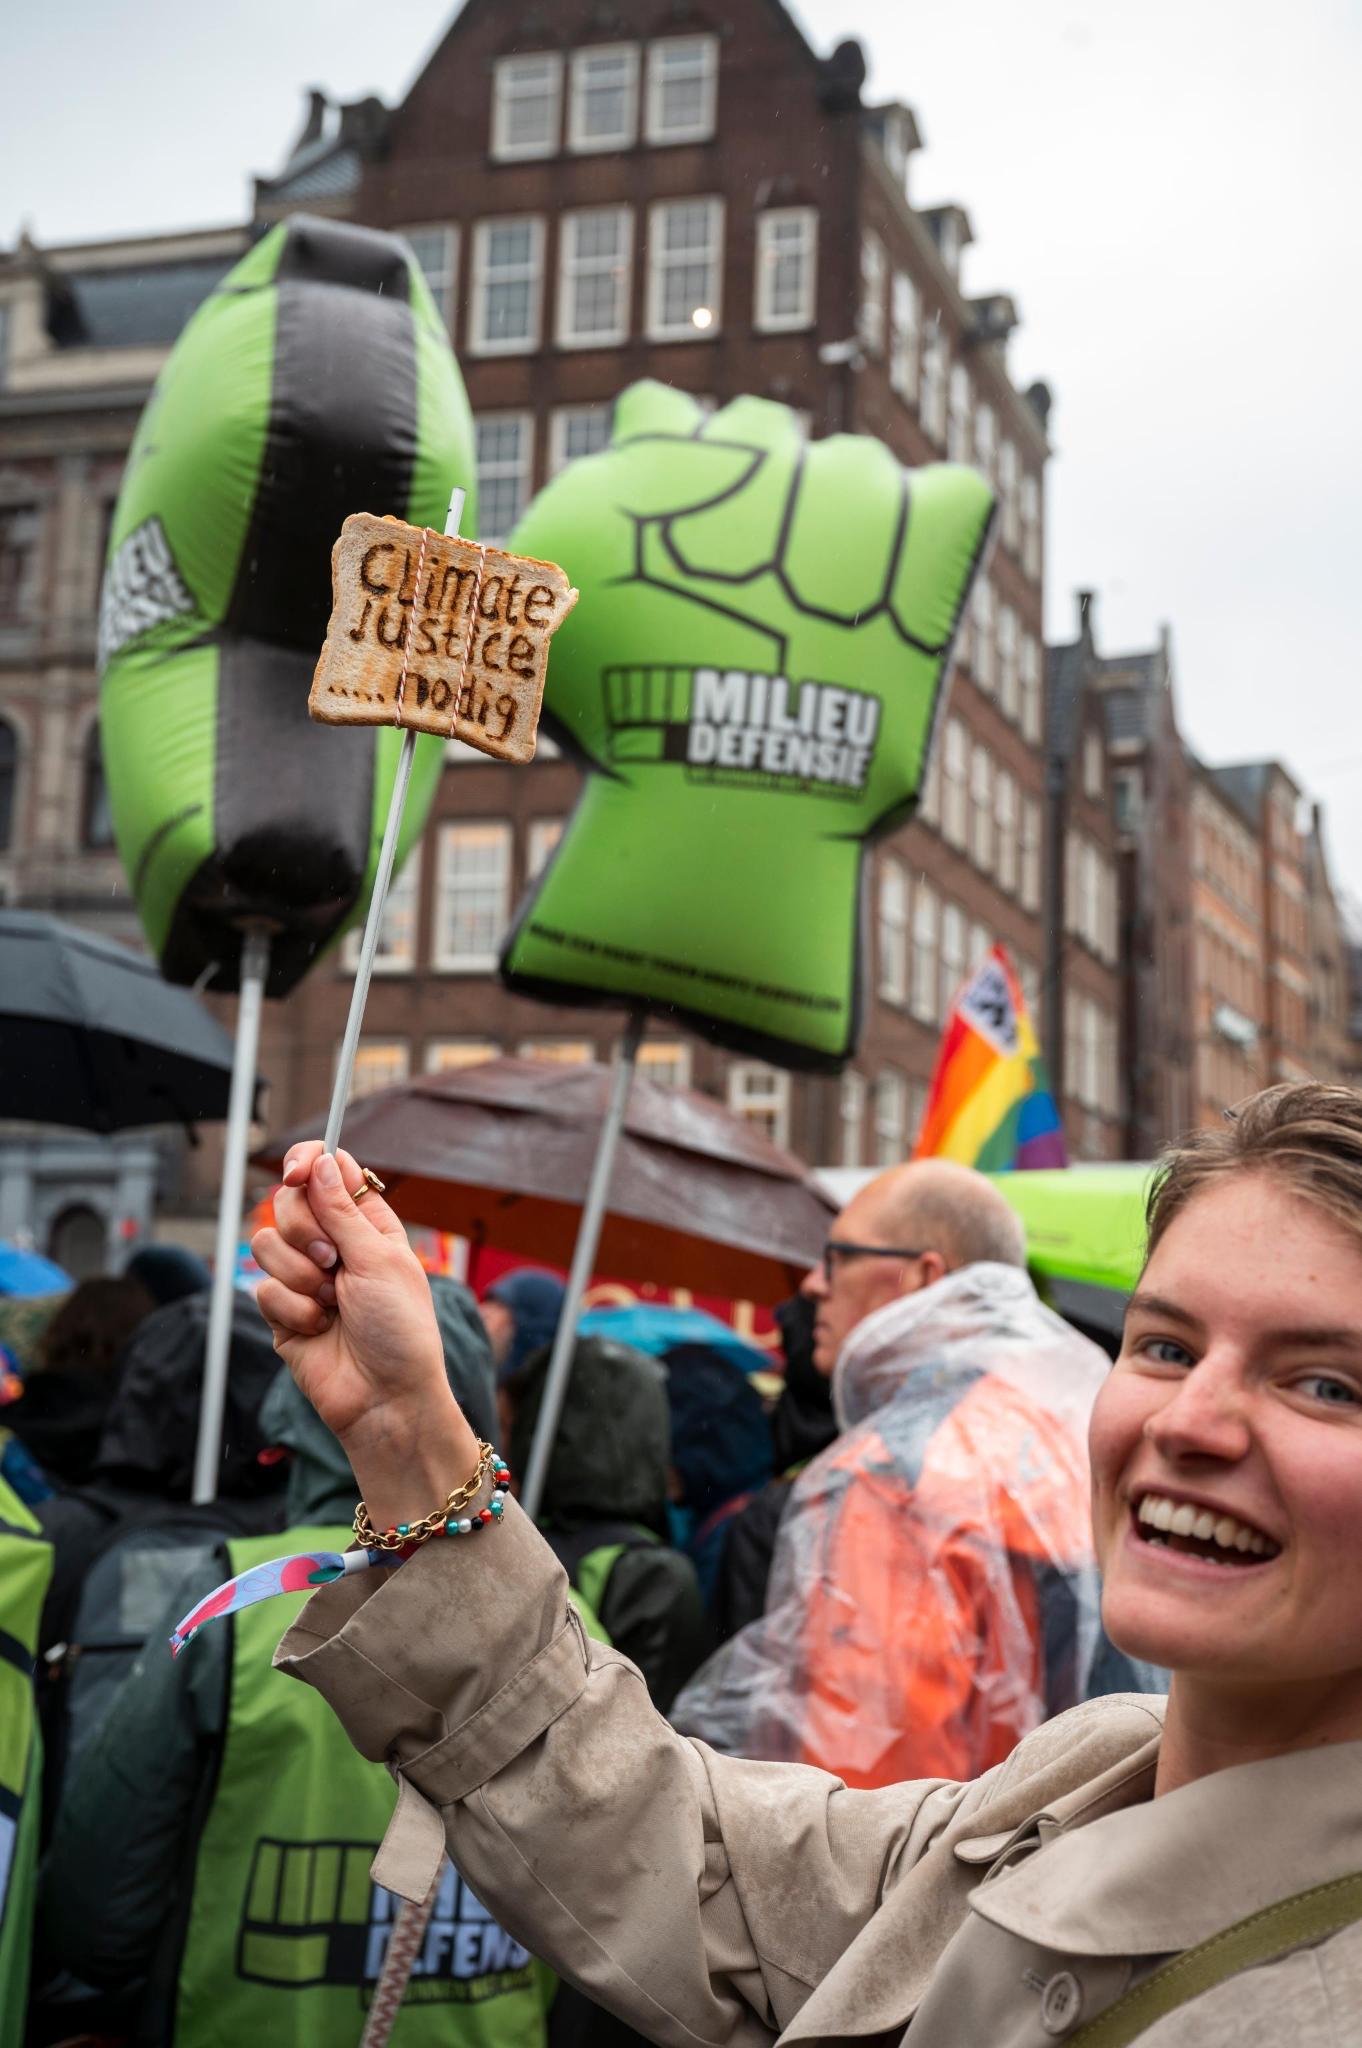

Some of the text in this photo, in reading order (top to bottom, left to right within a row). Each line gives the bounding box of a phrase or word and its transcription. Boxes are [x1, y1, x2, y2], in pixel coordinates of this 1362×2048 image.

[395, 671, 518, 742] nodig
[694, 667, 880, 746] MILIEU
[686, 723, 875, 789] DEFENSIE
